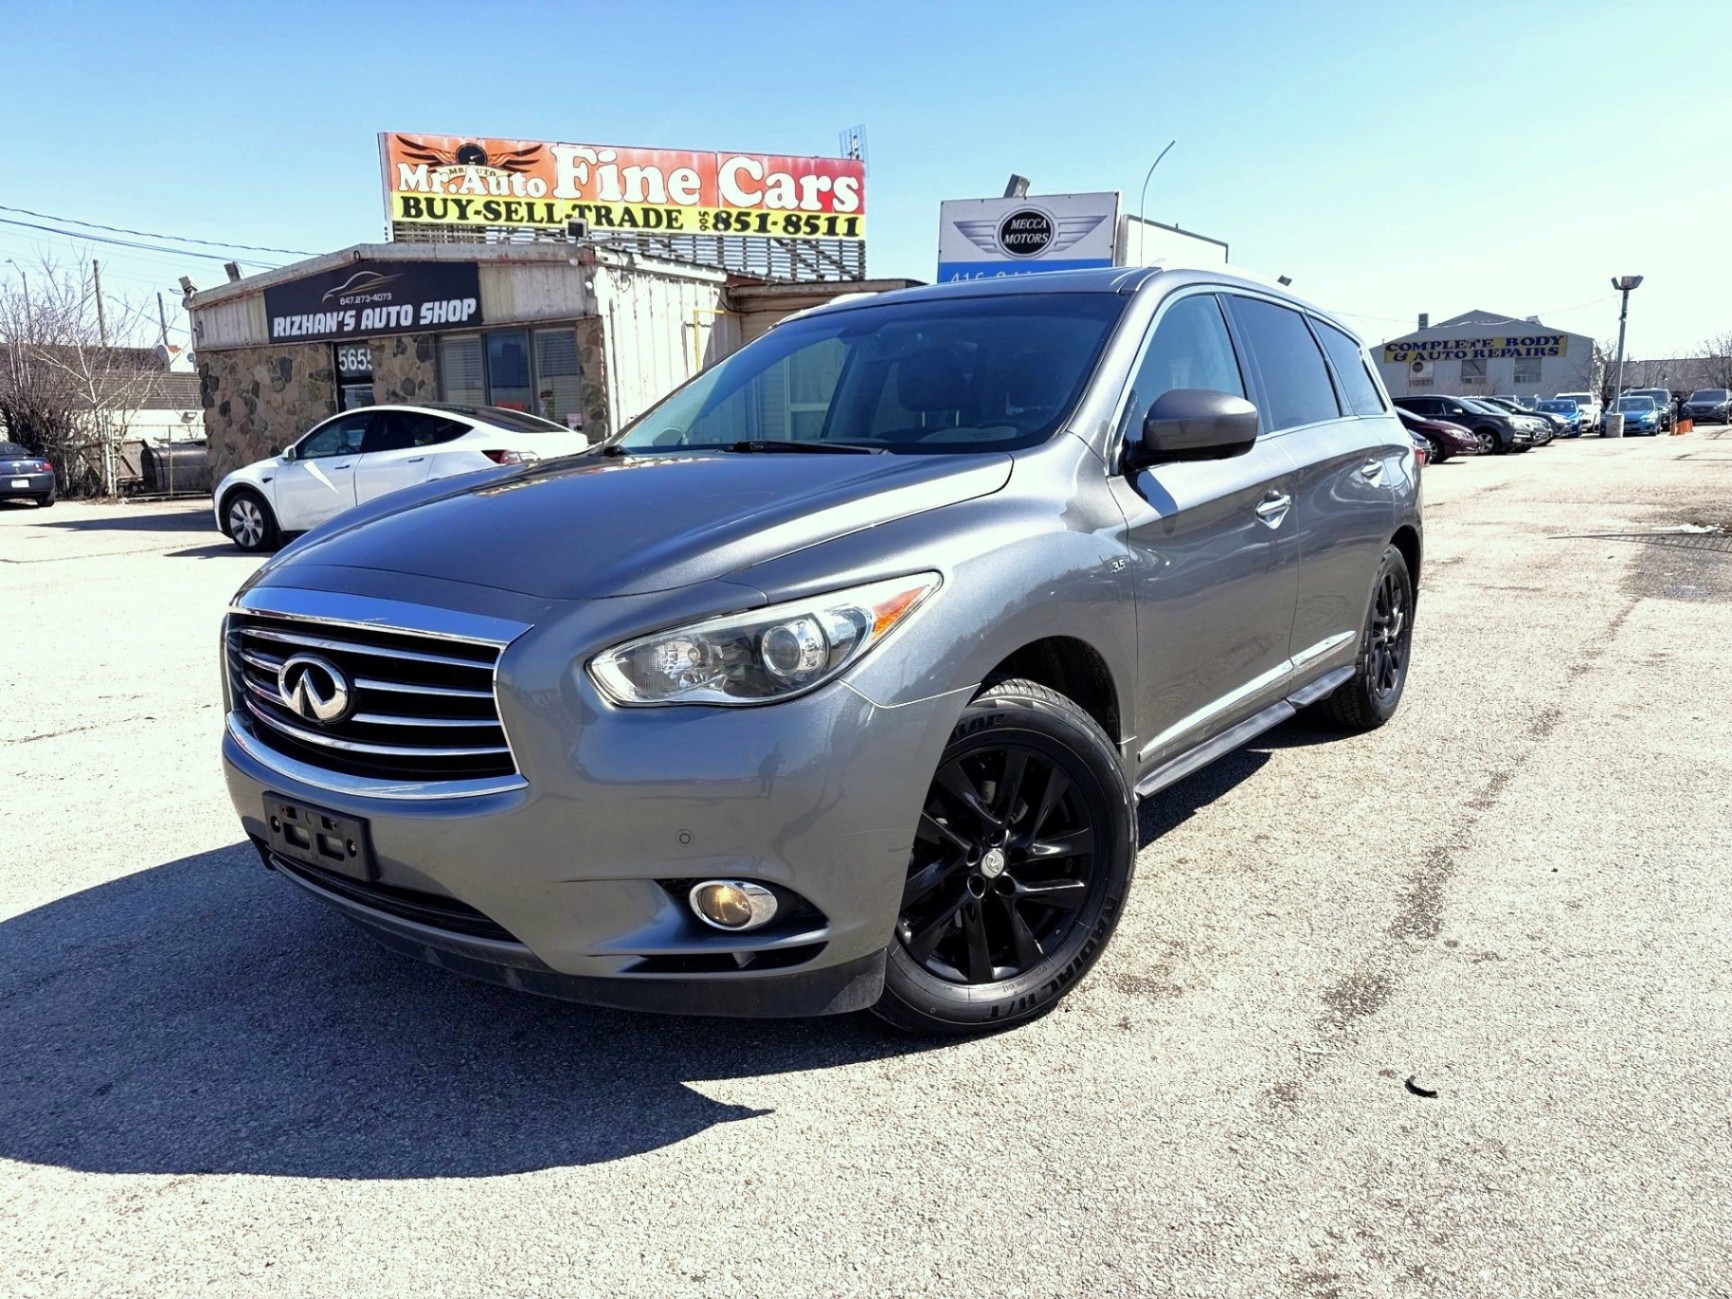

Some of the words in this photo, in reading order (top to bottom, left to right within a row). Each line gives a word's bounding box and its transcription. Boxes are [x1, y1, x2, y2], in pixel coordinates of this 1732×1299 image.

[550, 146, 702, 206] Fine
[718, 156, 859, 212] Cars
[699, 210, 710, 231] 905
[712, 210, 860, 237] 851-8511
[1010, 218, 1047, 229] MECCA
[1003, 233, 1049, 245] MOTORS
[273, 311, 356, 338] RIZHAN'S
[360, 304, 413, 330] AUTO
[419, 297, 477, 325] SHOP
[1385, 338, 1494, 352] COMPLETE
[1505, 335, 1564, 347] BODY
[1413, 350, 1467, 361] AUTO
[1473, 346, 1559, 359] REPAIRS
